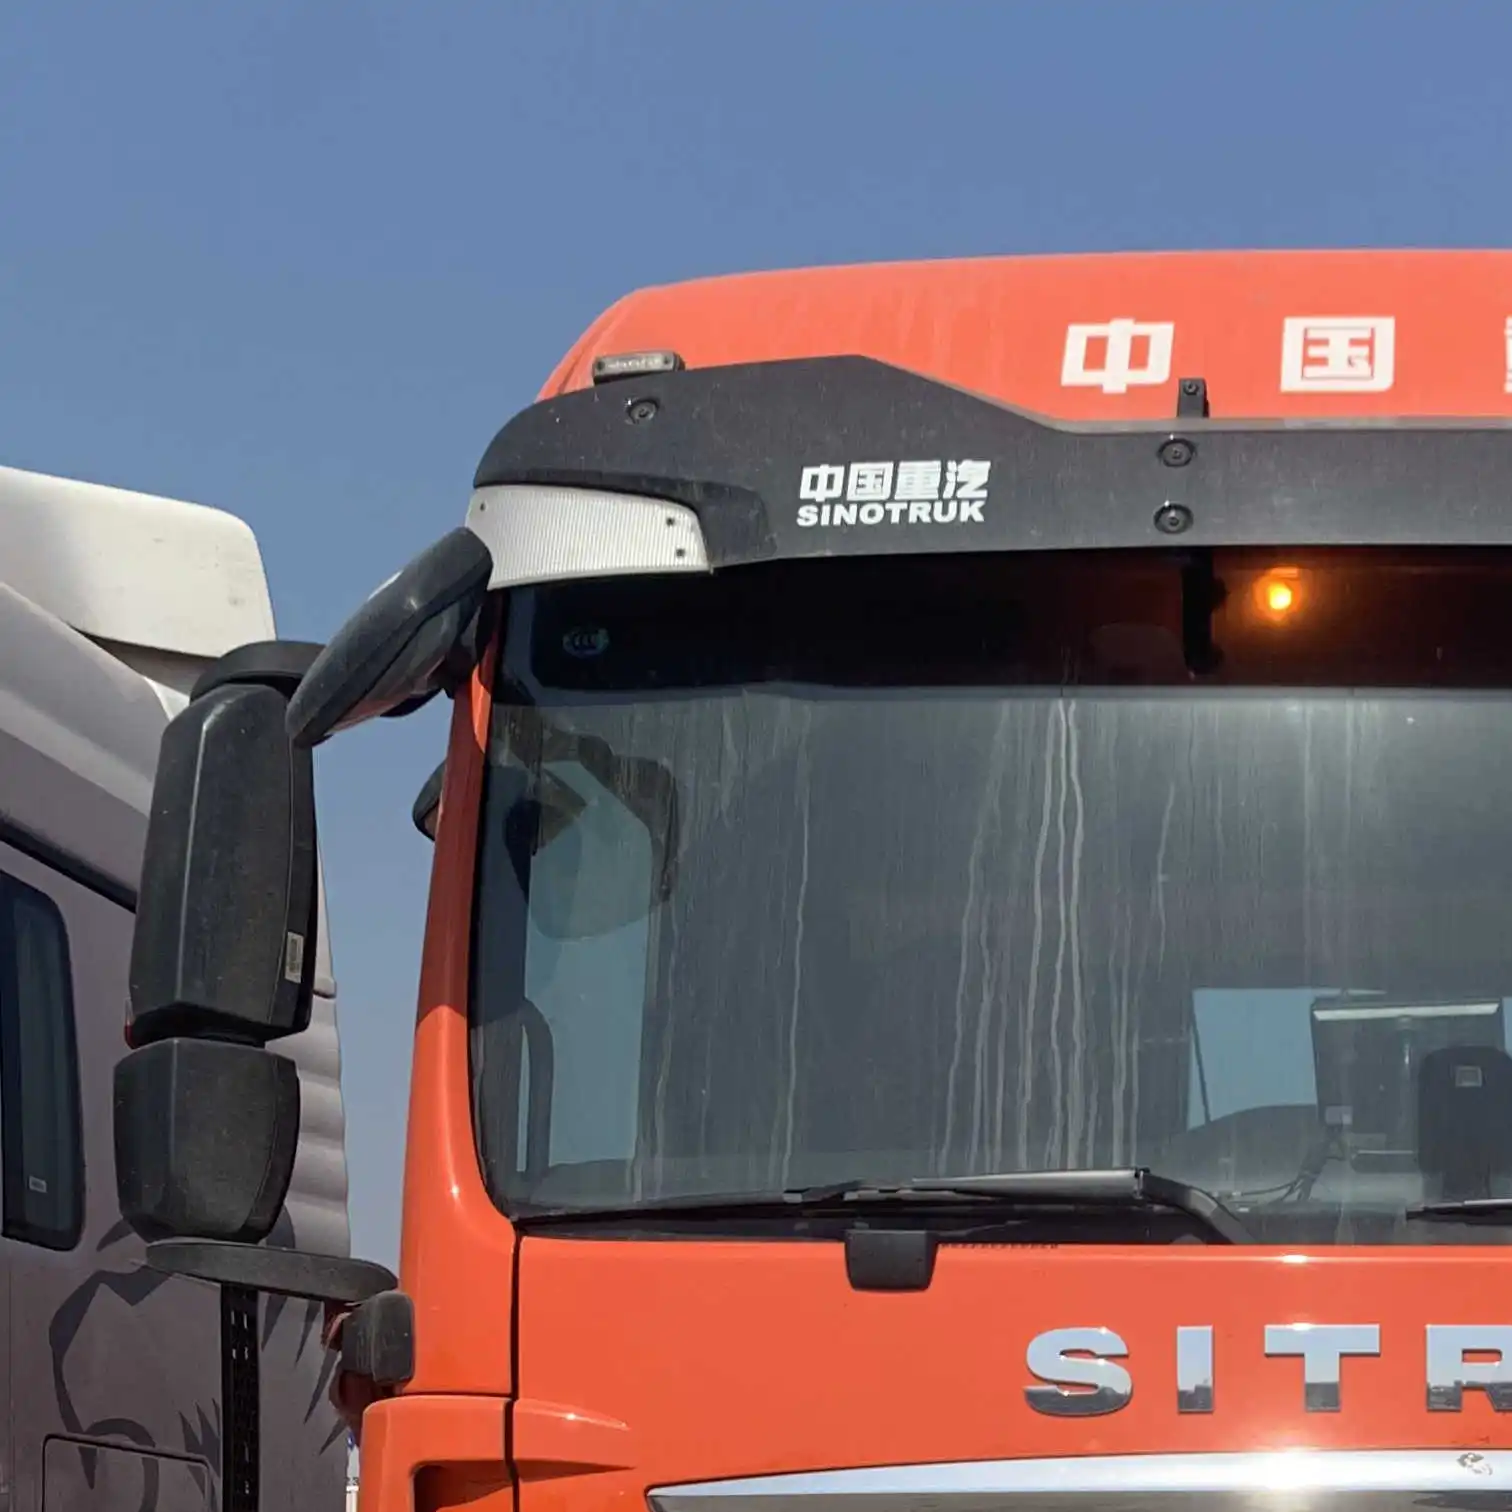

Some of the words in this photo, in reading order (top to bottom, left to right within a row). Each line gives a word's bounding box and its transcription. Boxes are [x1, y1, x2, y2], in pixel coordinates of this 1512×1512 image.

[800, 459, 992, 502] 中国重汽
[796, 499, 986, 527] SINOTRUK
